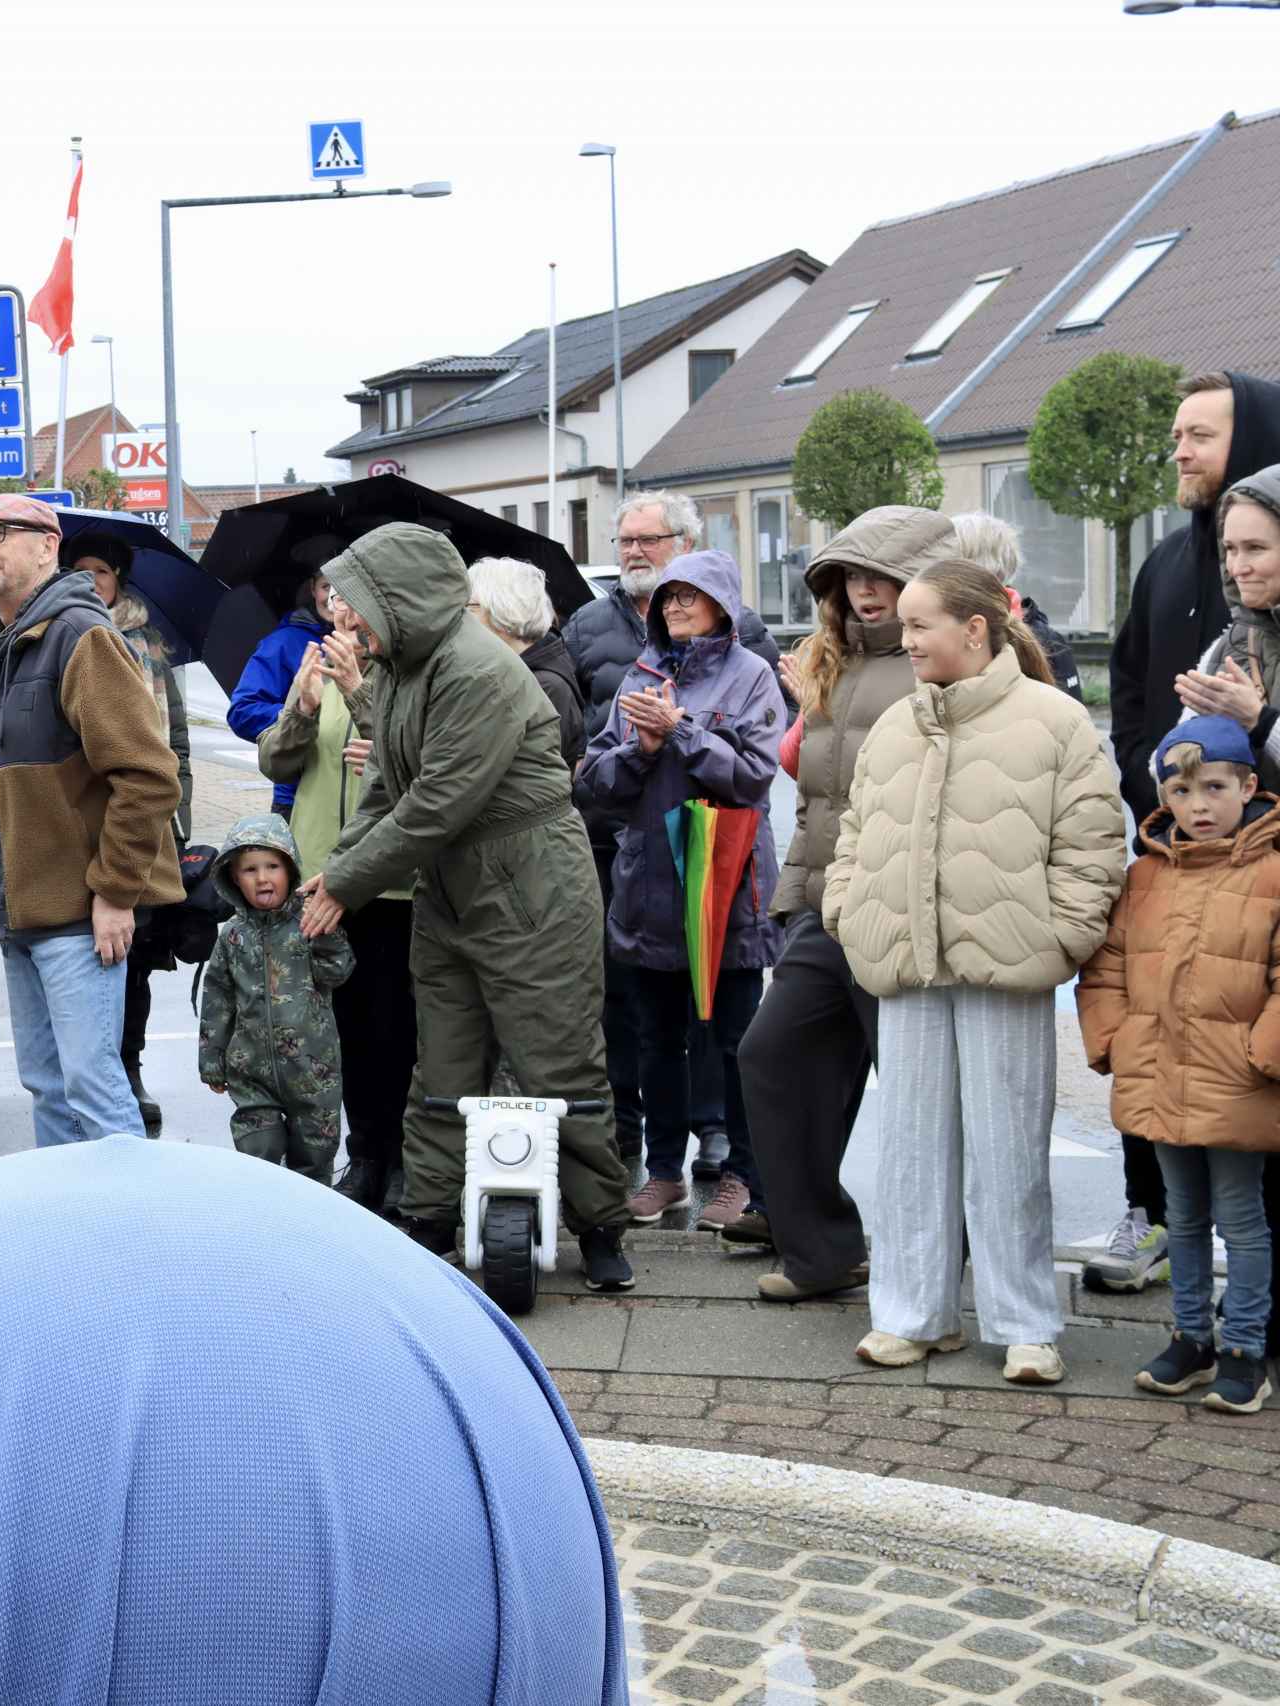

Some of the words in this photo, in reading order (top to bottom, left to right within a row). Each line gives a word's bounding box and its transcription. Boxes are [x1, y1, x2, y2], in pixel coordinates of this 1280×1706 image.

[111, 441, 167, 469] OK
[123, 487, 161, 502] udsen
[142, 511, 169, 526] 13.6
[492, 1101, 533, 1111] POLICE
